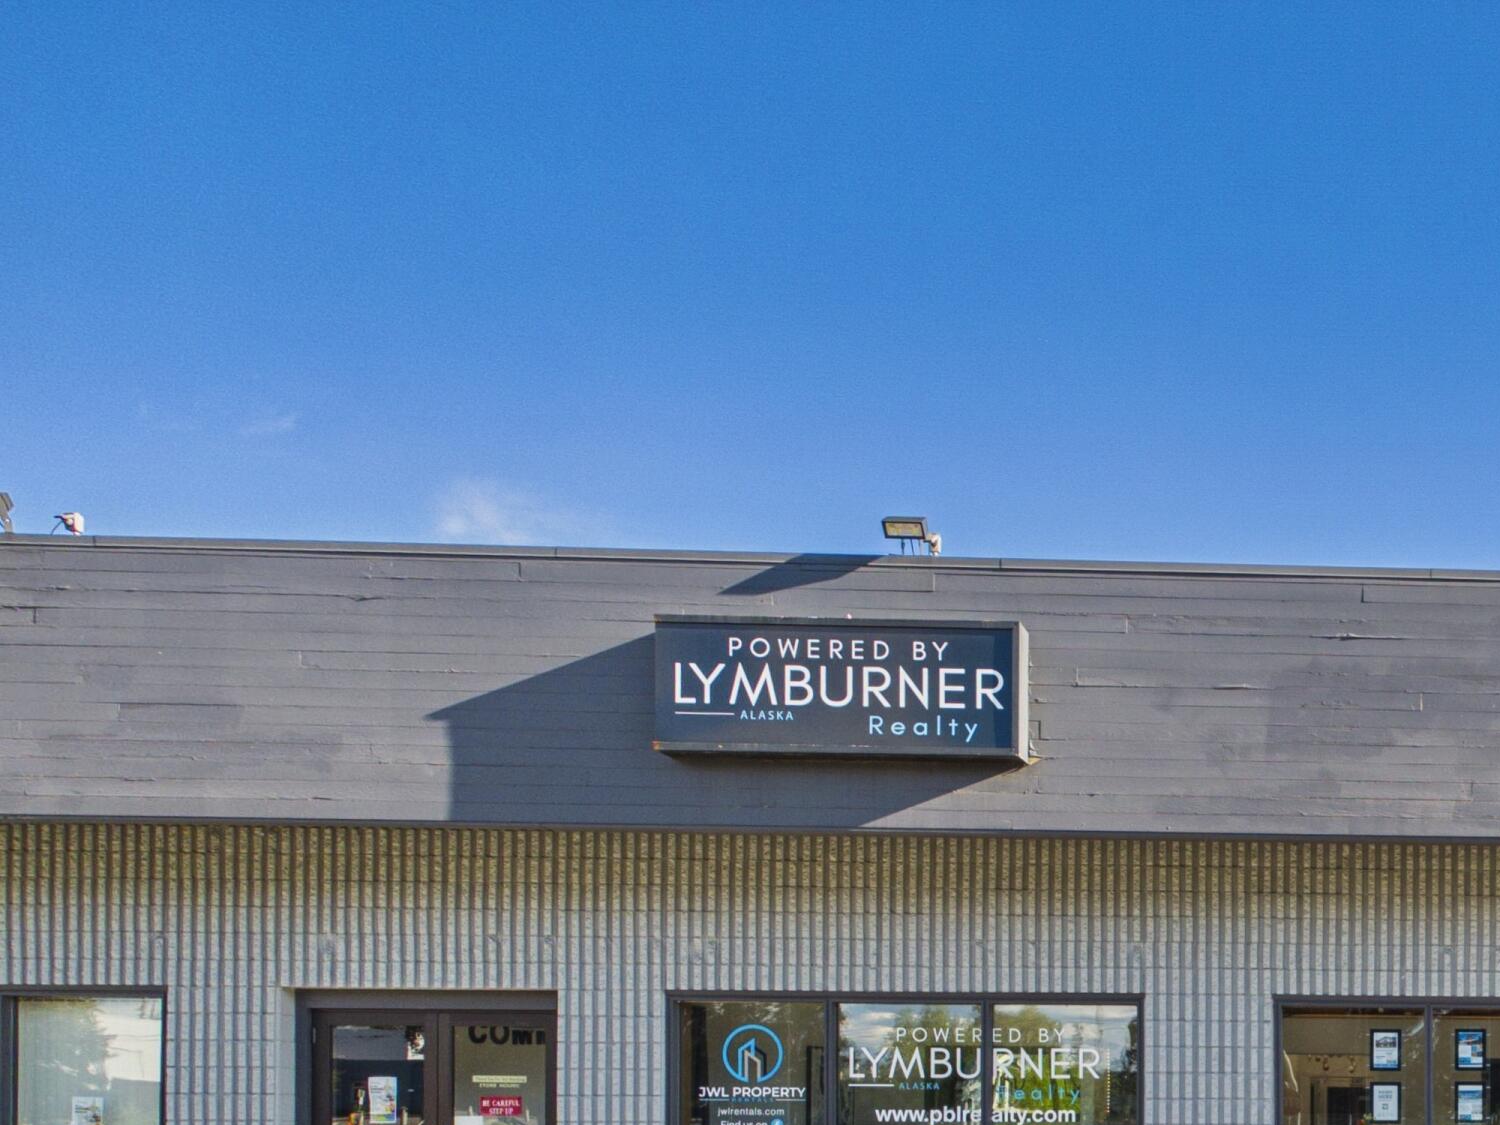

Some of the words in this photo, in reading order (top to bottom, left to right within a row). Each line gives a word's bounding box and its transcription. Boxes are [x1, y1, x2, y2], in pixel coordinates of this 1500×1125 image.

[728, 637, 890, 661] POWERED
[912, 641, 949, 661] BY
[674, 662, 1004, 710] LYMBURNER
[740, 709, 794, 721] ALASKA
[868, 715, 978, 742] Realty
[896, 1027, 1021, 1043] POWERED
[1038, 1027, 1064, 1043] BY
[848, 1046, 1100, 1080] LYMBURNER
[699, 1086, 730, 1098] JWL
[732, 1086, 806, 1098] PROPERTY
[899, 1082, 941, 1090] ALASKA
[717, 1107, 785, 1117] jwlrentals.com
[875, 1105, 1077, 1125] www.pblrealty.com
